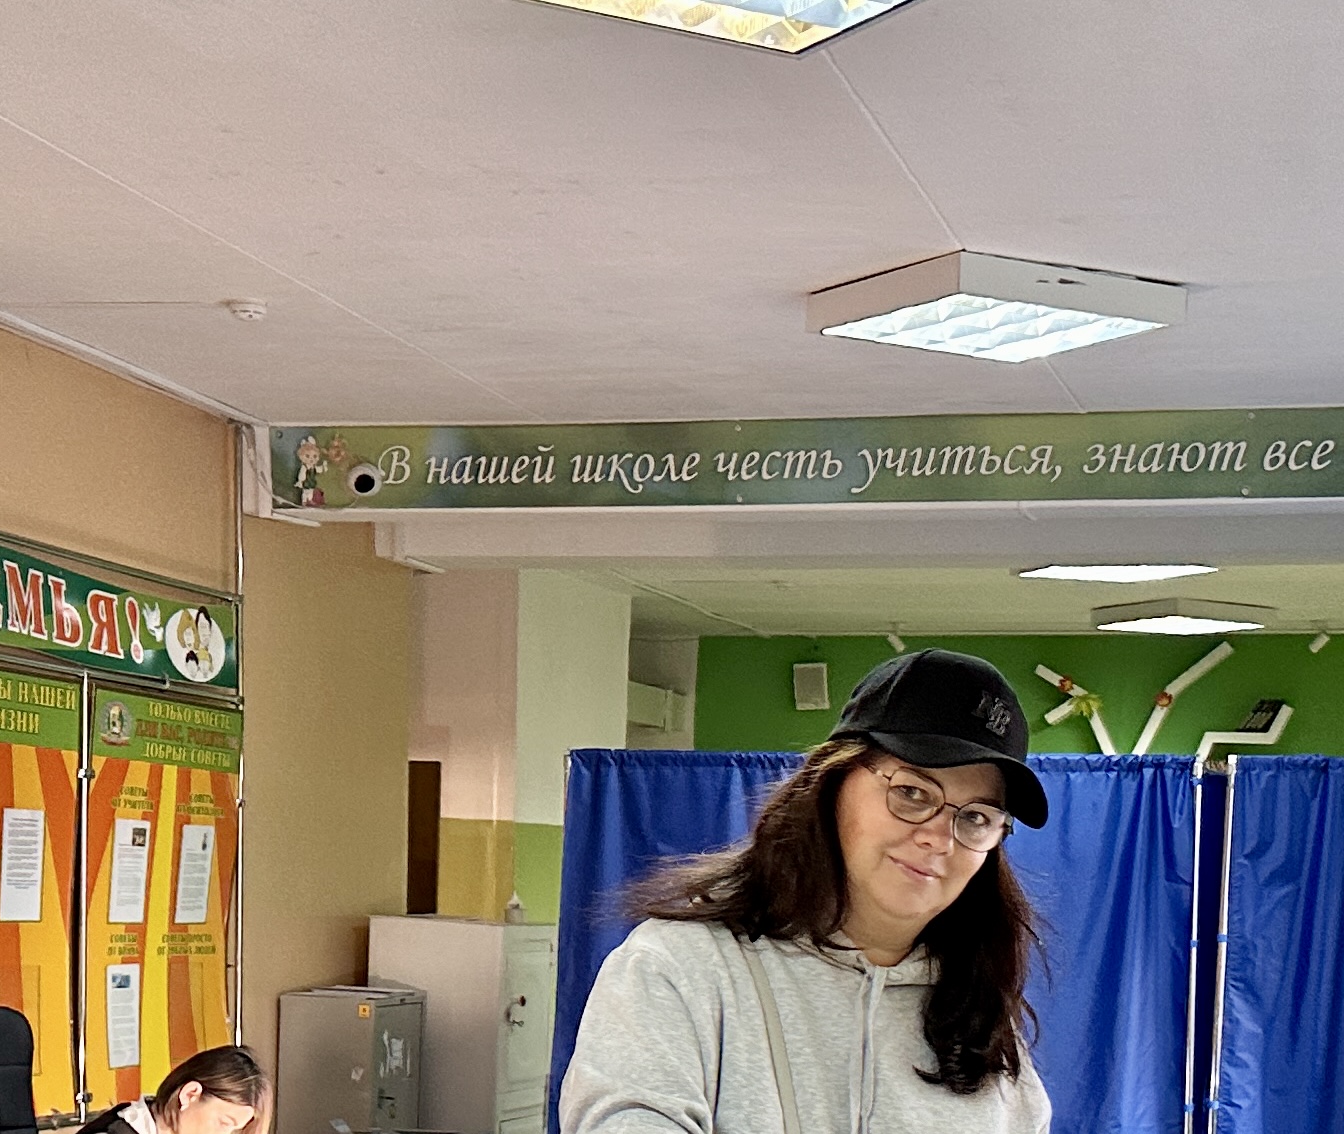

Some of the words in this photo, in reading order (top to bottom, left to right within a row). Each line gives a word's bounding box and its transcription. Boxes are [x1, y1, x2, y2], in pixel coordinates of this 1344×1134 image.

[378, 445, 412, 486] В
[425, 443, 558, 487] нашей
[569, 452, 700, 495] школе
[714, 445, 844, 482] честь
[849, 440, 1064, 495] учиться,
[1082, 429, 1248, 475] знают
[1262, 435, 1333, 472] все
[17, 681, 77, 711] НАШЕЙ
[148, 700, 192, 723] ТОЛЬКО
